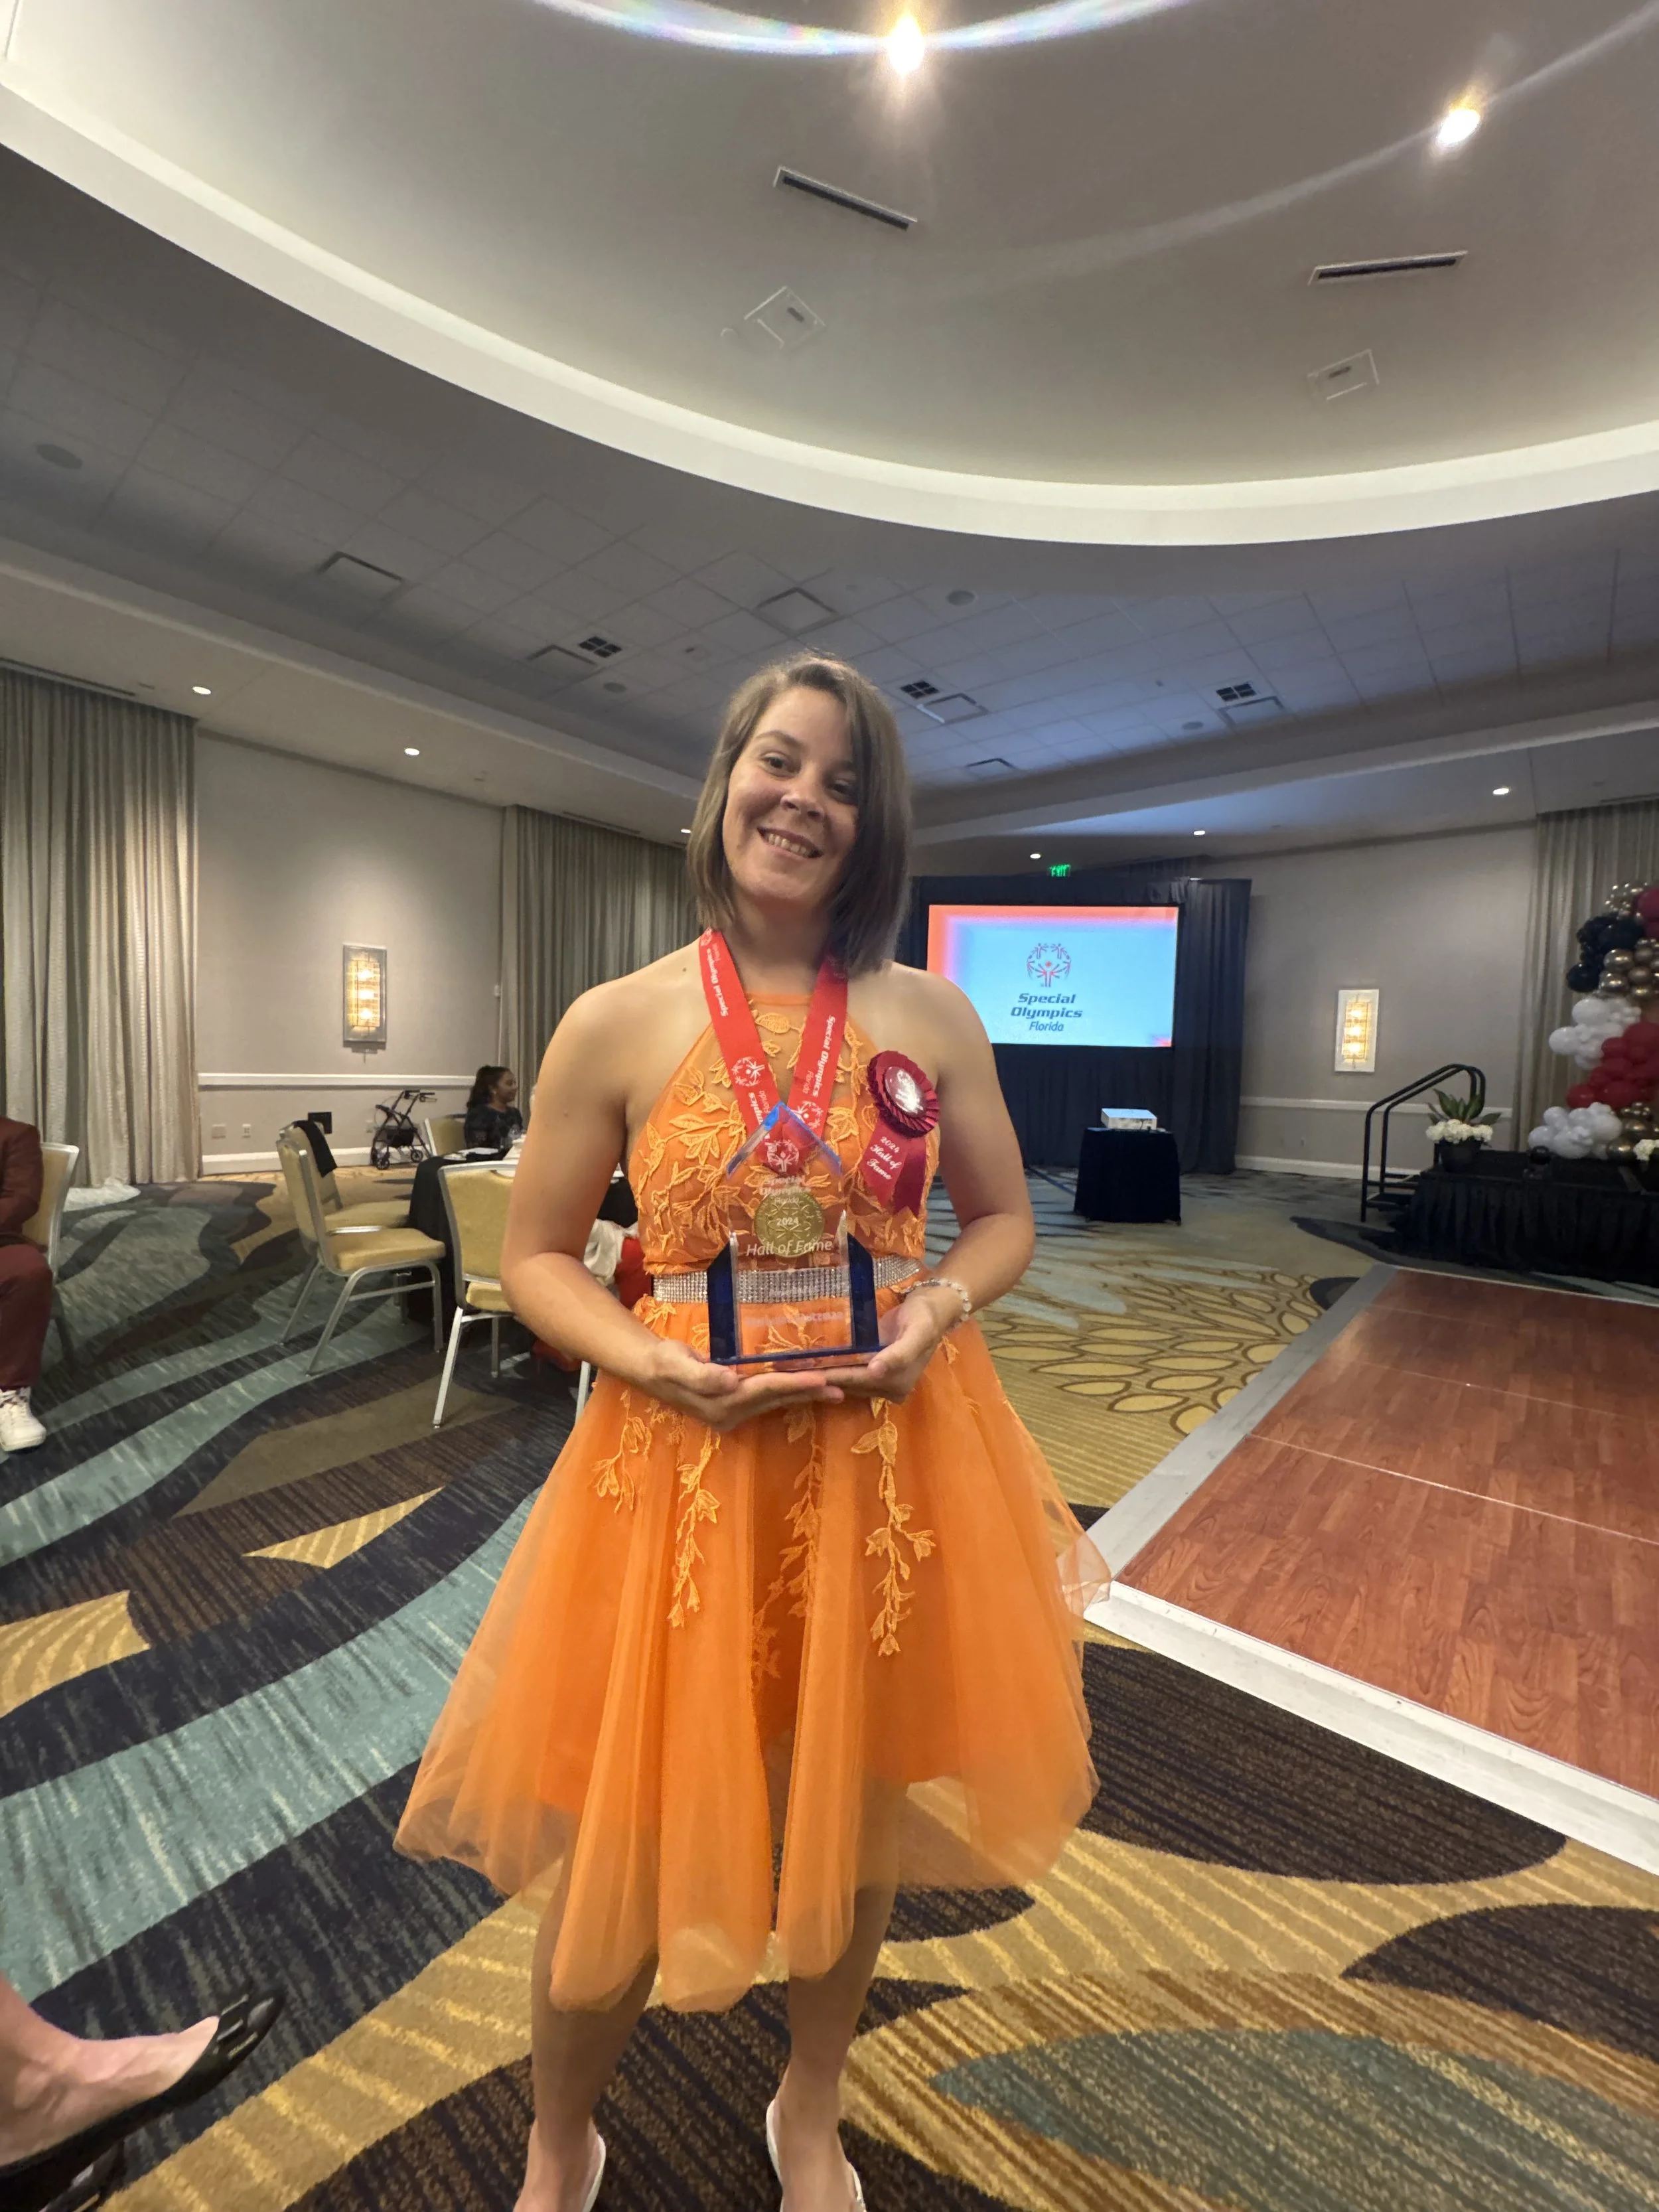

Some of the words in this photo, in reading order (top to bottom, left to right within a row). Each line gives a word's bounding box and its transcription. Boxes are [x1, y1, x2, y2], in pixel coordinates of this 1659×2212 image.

[713, 985, 729, 1016] Special
[1018, 993, 1076, 1005] Special
[1011, 1007, 1082, 1019] Olympics
[824, 1015, 835, 1050] Special
[1029, 1021, 1064, 1031] Florida
[812, 1051, 829, 1097] Olympics
[880, 1136, 900, 1153] 2024
[870, 1144, 893, 1162] Hall
[889, 1161, 902, 1170] of
[867, 1158, 892, 1179] Fame
[776, 1217, 799, 1226] 2024
[746, 1241, 774, 1256] Hall
[778, 1239, 794, 1256] of
[794, 1240, 833, 1253] Fame
